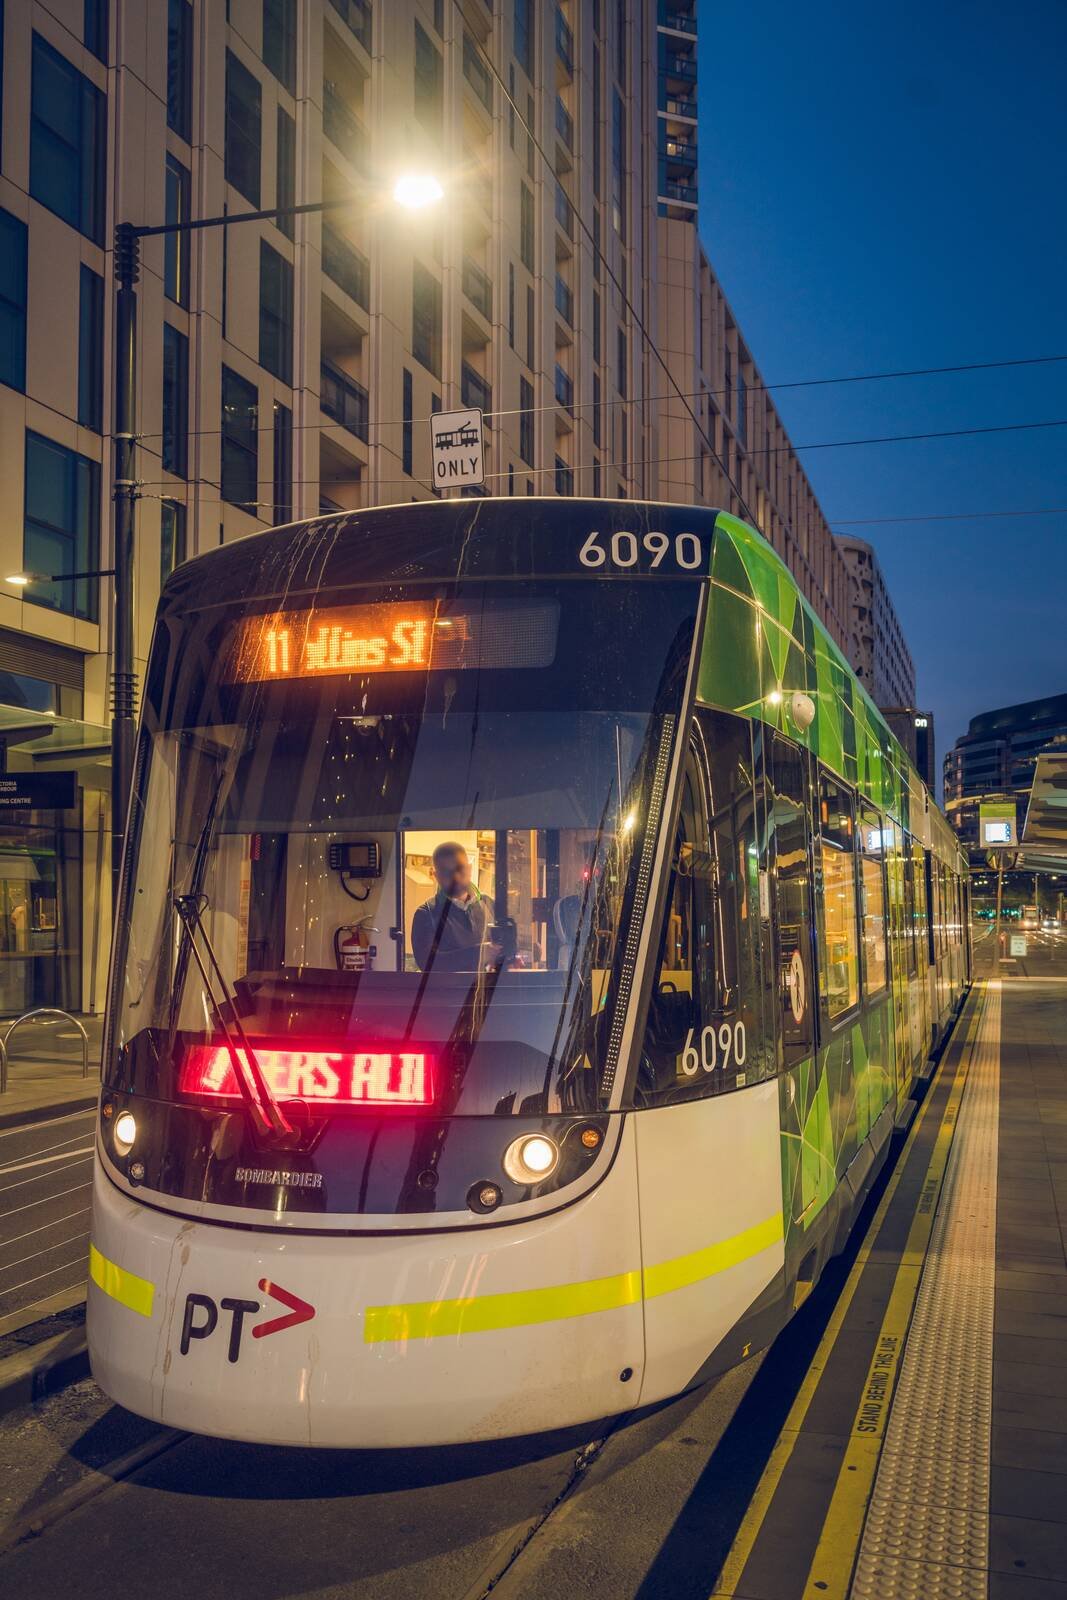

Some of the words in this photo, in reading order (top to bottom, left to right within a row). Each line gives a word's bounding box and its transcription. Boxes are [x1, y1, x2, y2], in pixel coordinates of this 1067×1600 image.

[437, 457, 478, 478] ONLY
[579, 531, 702, 569] 6090
[266, 630, 289, 672] 11
[682, 1020, 746, 1076] 6090
[235, 1167, 323, 1187] BOMBARDIER
[879, 1336, 898, 1352] LINE
[874, 1352, 894, 1369] THIS
[866, 1371, 889, 1401] BEHIND
[857, 1403, 882, 1433] STAND
